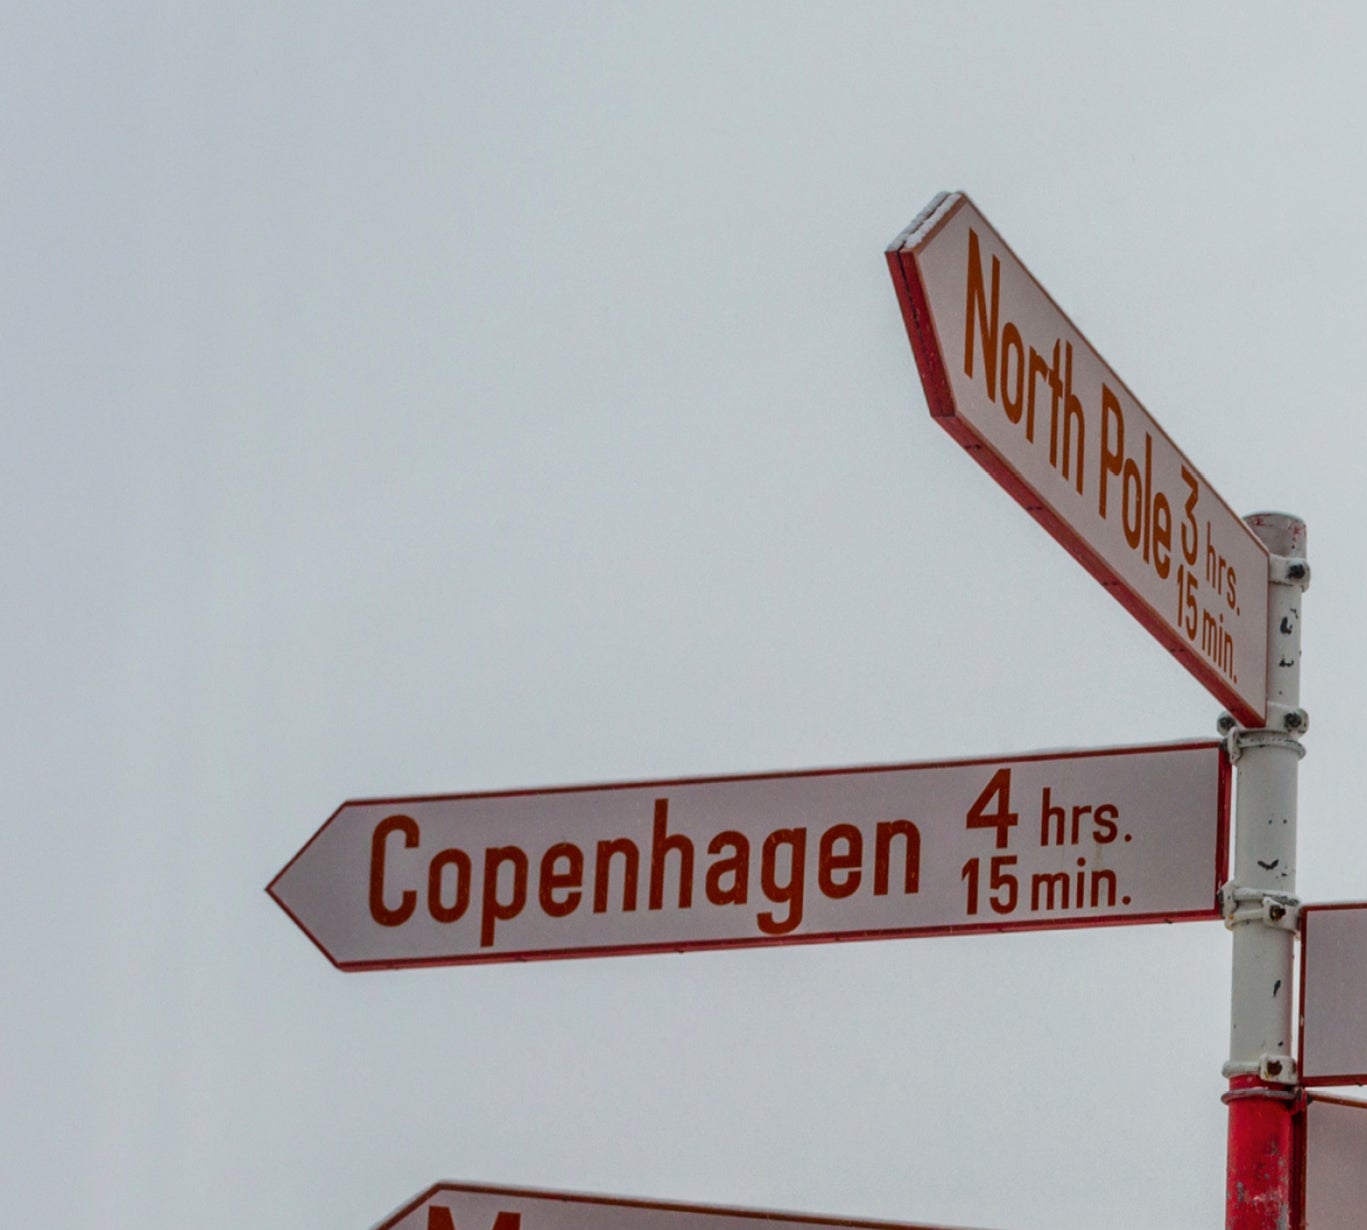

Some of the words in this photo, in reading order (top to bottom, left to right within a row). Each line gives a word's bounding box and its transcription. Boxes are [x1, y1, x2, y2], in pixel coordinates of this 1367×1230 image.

[963, 228, 1085, 496] North
[1098, 382, 1173, 580] Pole
[1180, 465, 1199, 567] 3
[1206, 522, 1241, 616] hrs.
[1176, 564, 1198, 641] 15
[1201, 609, 1238, 684] min.
[368, 797, 921, 948] Copenhagen
[965, 767, 1020, 850] 4
[1040, 786, 1133, 847] hrs.
[961, 854, 1019, 916] 15
[1030, 857, 1132, 912] min.
